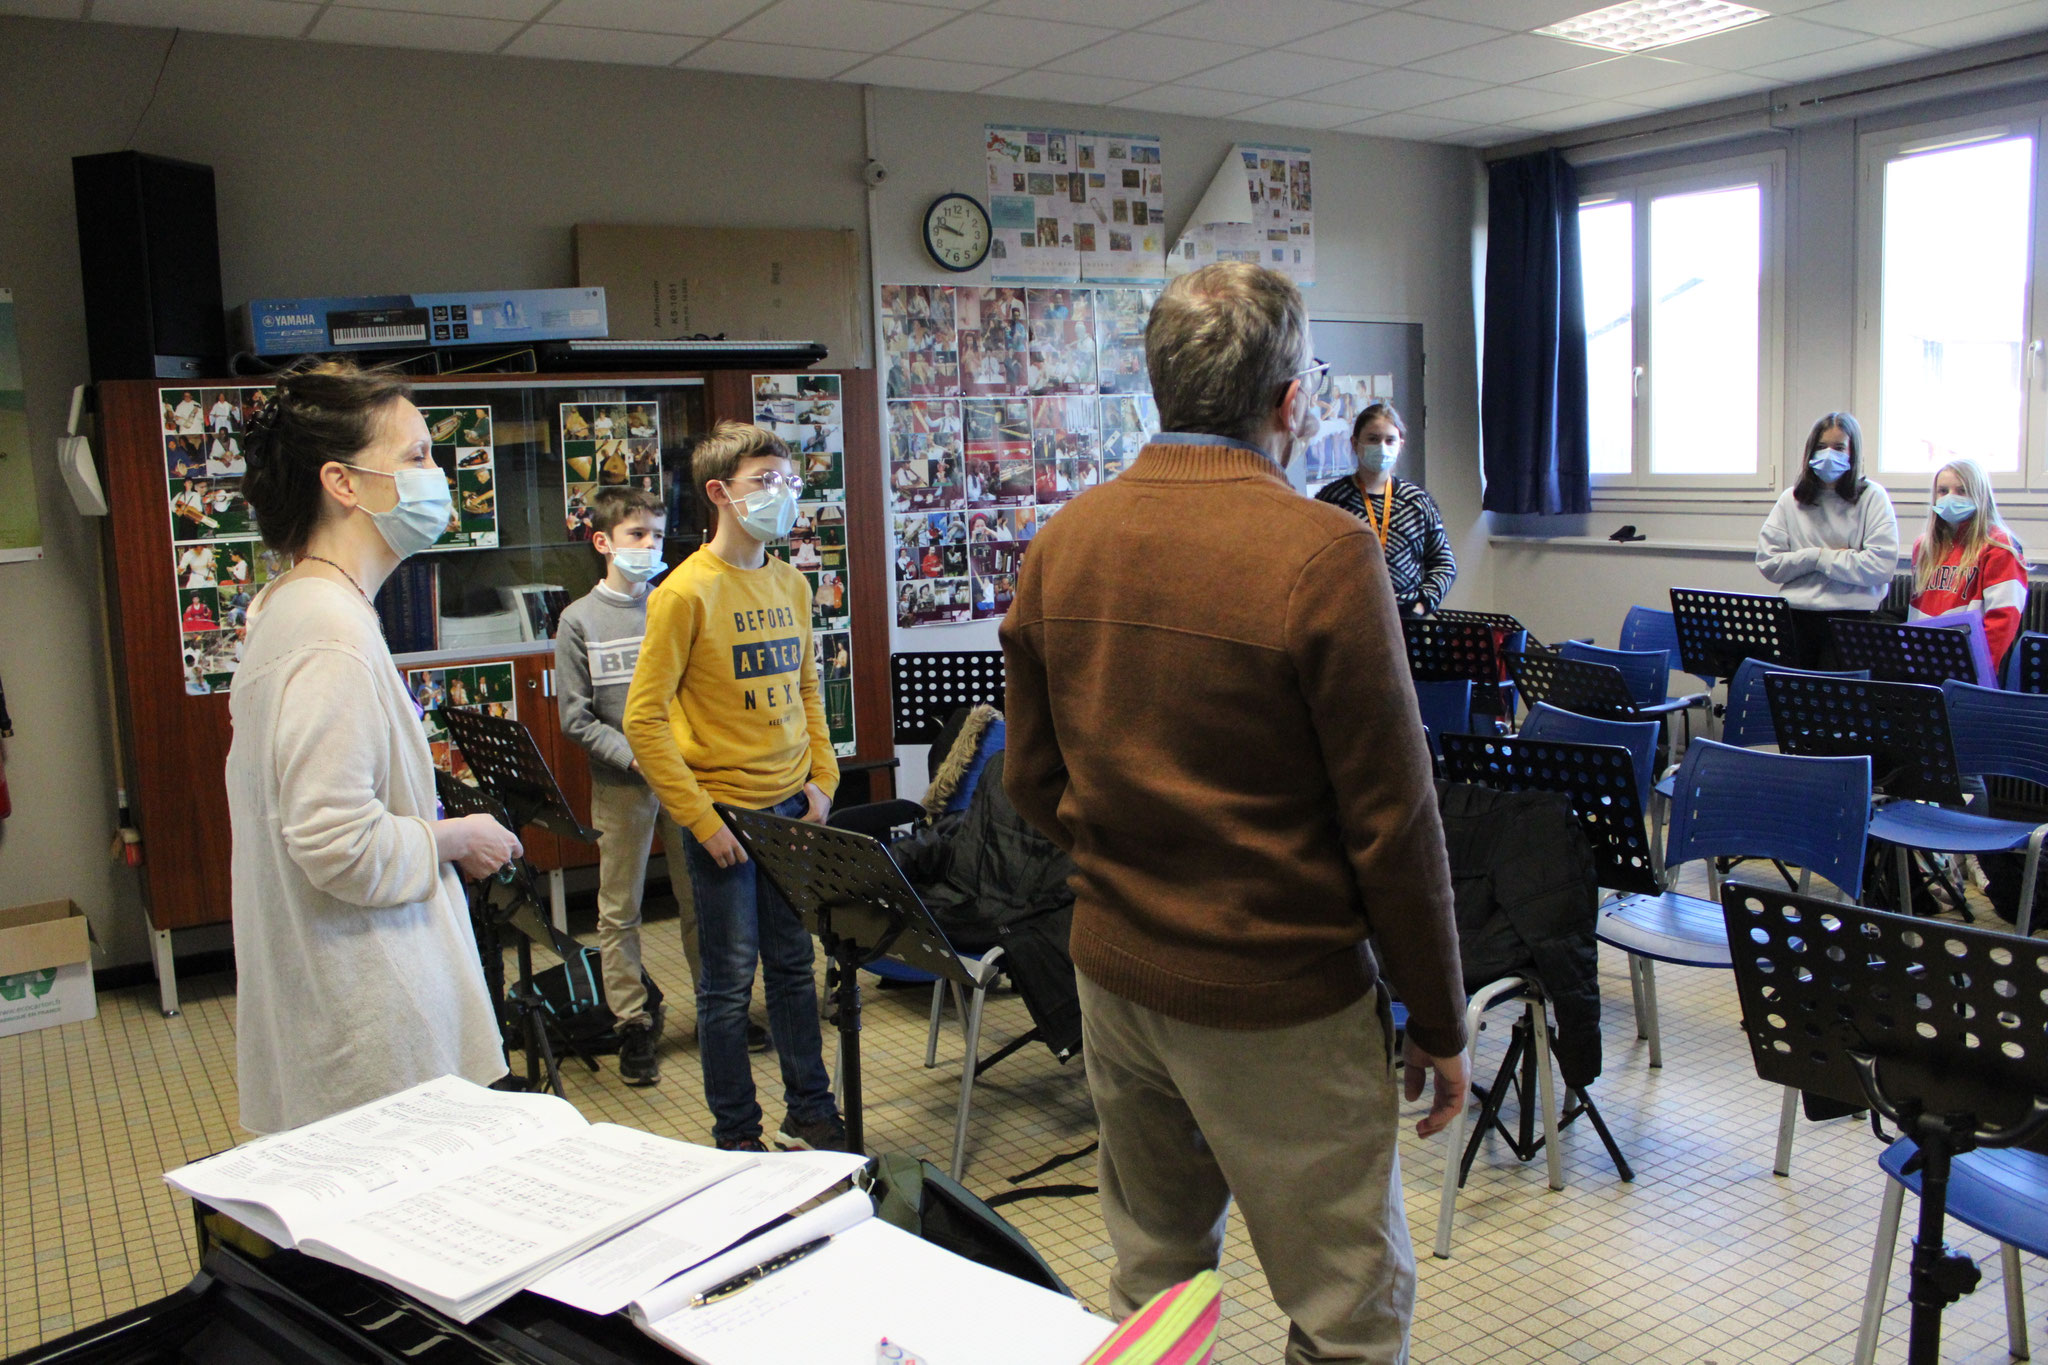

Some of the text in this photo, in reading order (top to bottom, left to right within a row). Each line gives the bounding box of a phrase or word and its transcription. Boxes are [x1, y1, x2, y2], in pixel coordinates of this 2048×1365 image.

[944, 208, 951, 216] 11
[954, 205, 962, 214] 12
[937, 216, 946, 226] 10
[669, 283, 678, 324] KS-1001
[274, 314, 316, 327] YAMAHA
[741, 645, 799, 673] AFTER
[745, 681, 800, 710] NEX
